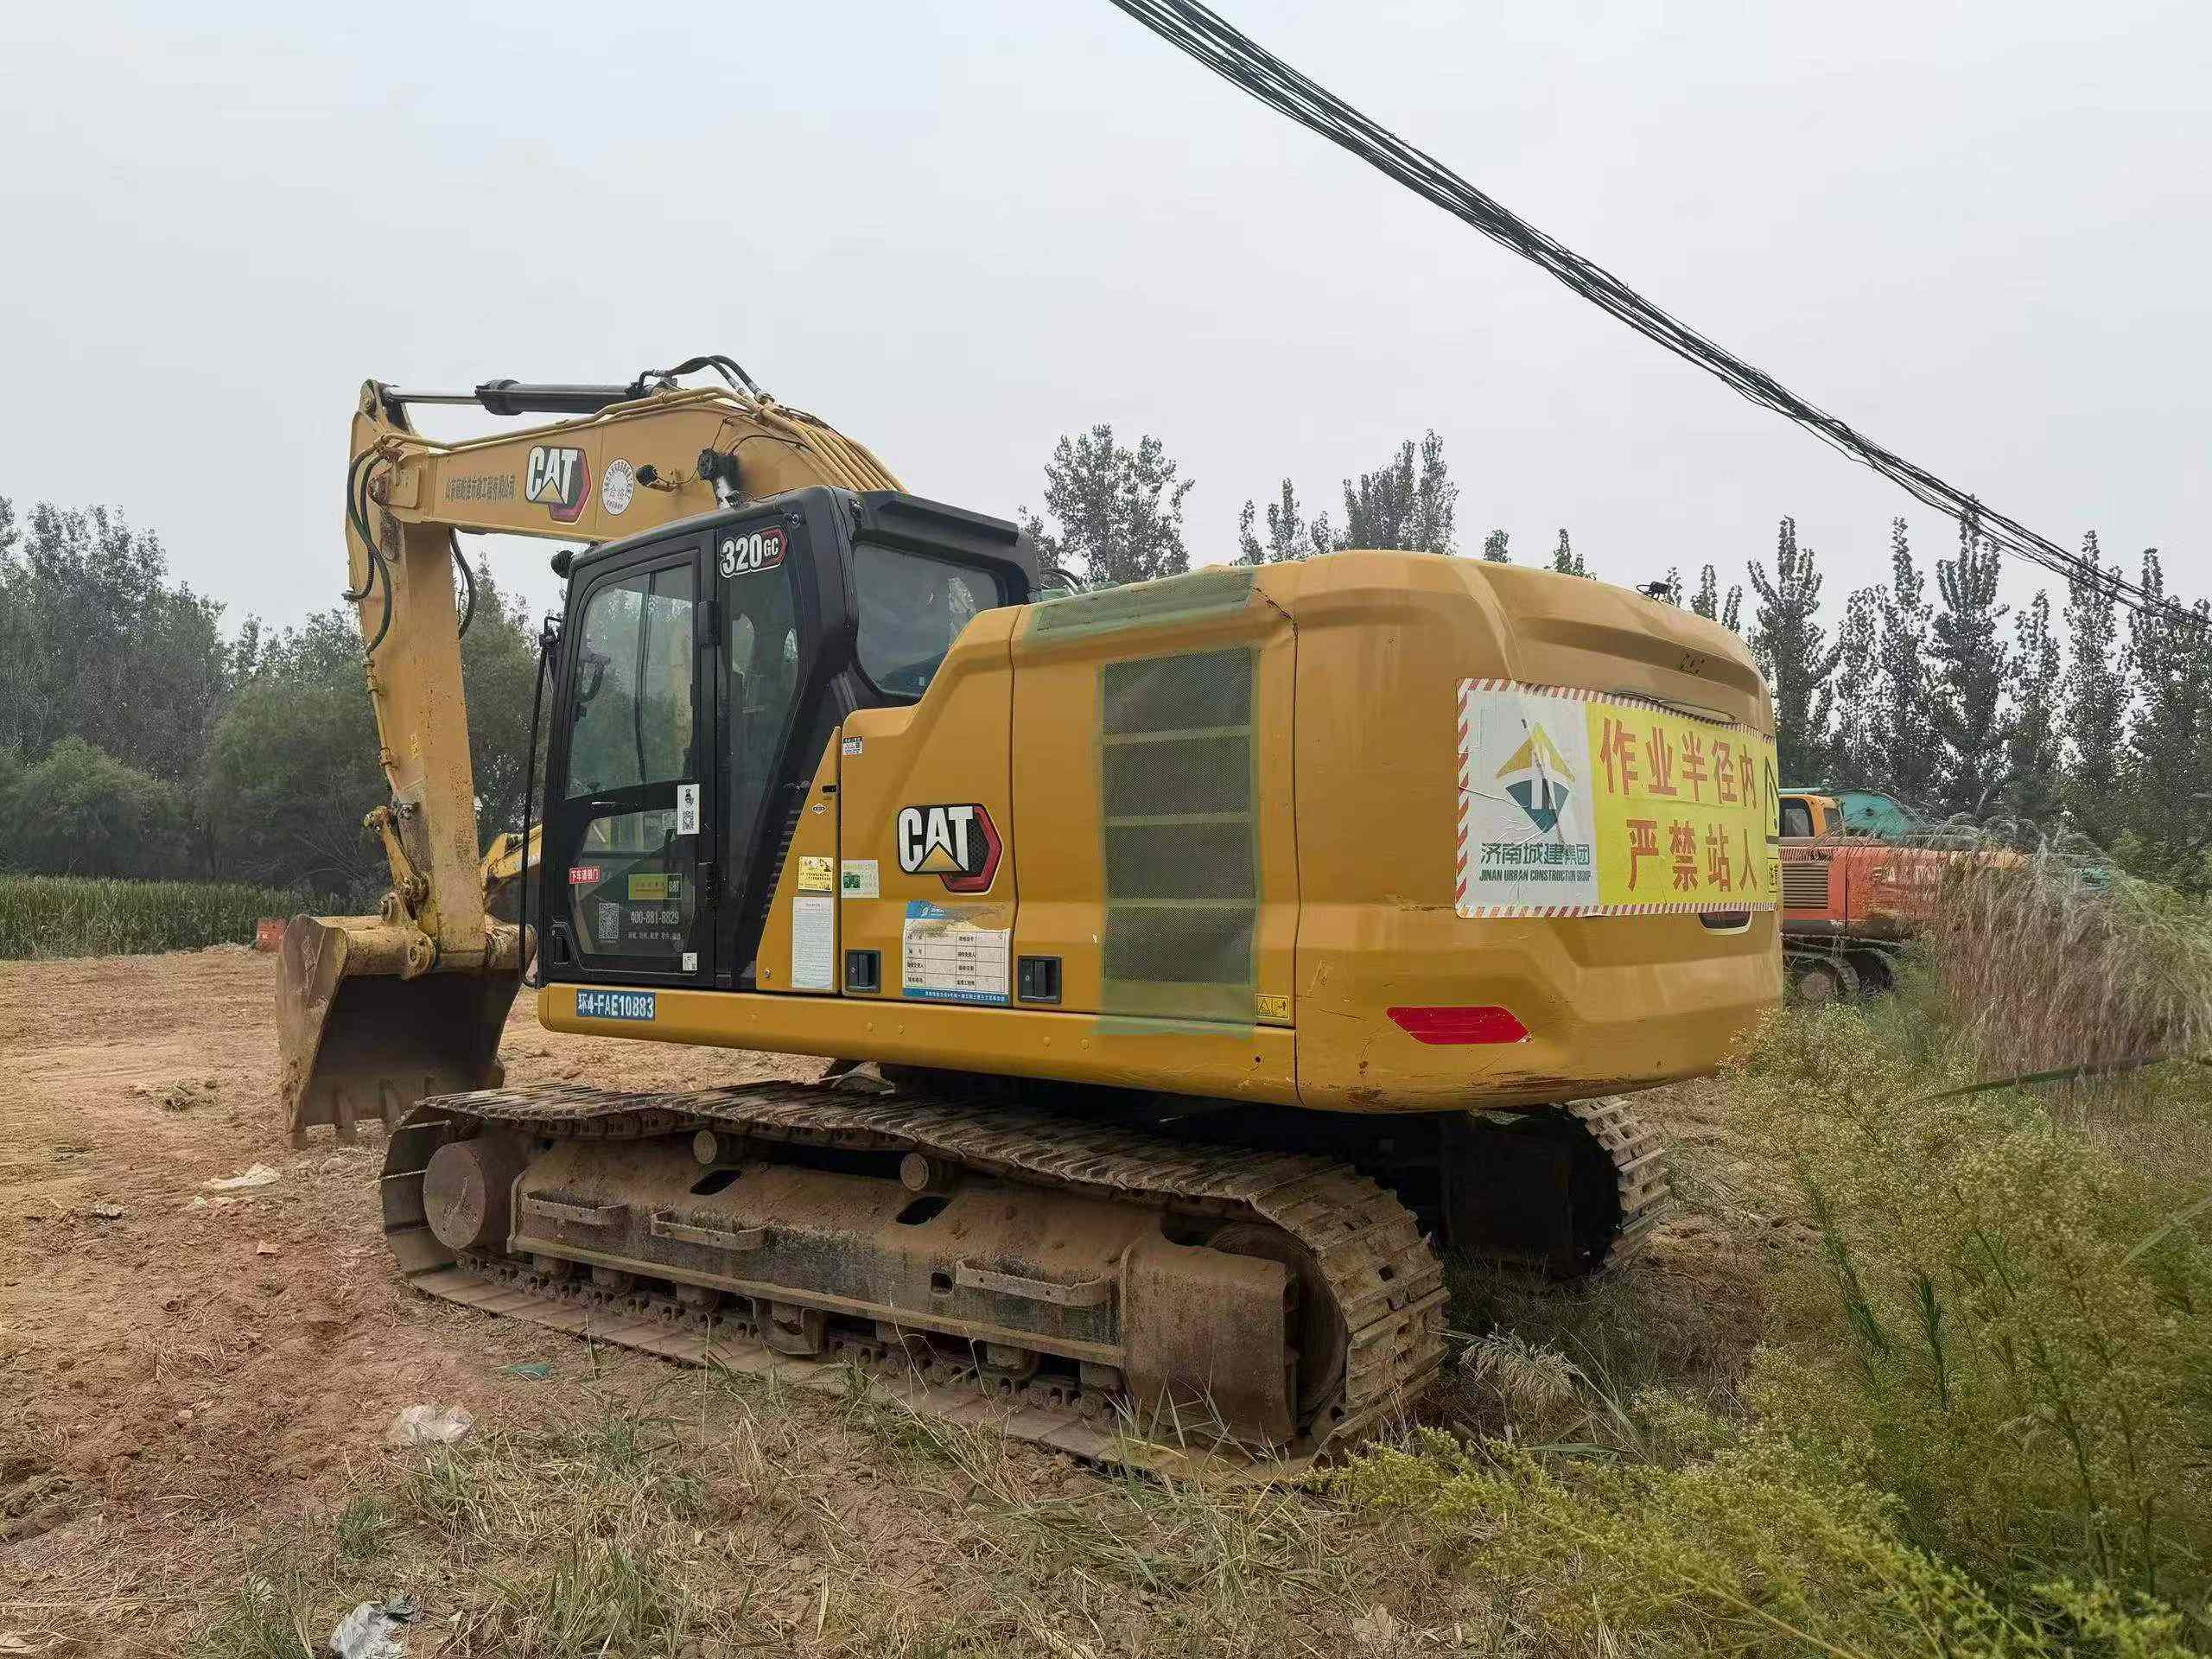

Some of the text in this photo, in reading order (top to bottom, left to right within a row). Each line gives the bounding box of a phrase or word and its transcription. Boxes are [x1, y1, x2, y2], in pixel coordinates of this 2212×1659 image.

[525, 446, 578, 505] CAT
[722, 533, 779, 574] 320 GC
[1600, 717, 1757, 809] 作业半径内
[899, 806, 973, 872] CAT
[1480, 842, 1591, 865] 济南城建集团
[1626, 819, 1758, 892] 严禁站人
[1479, 869, 1502, 881] JINAN
[1503, 869, 1529, 881] URBAN
